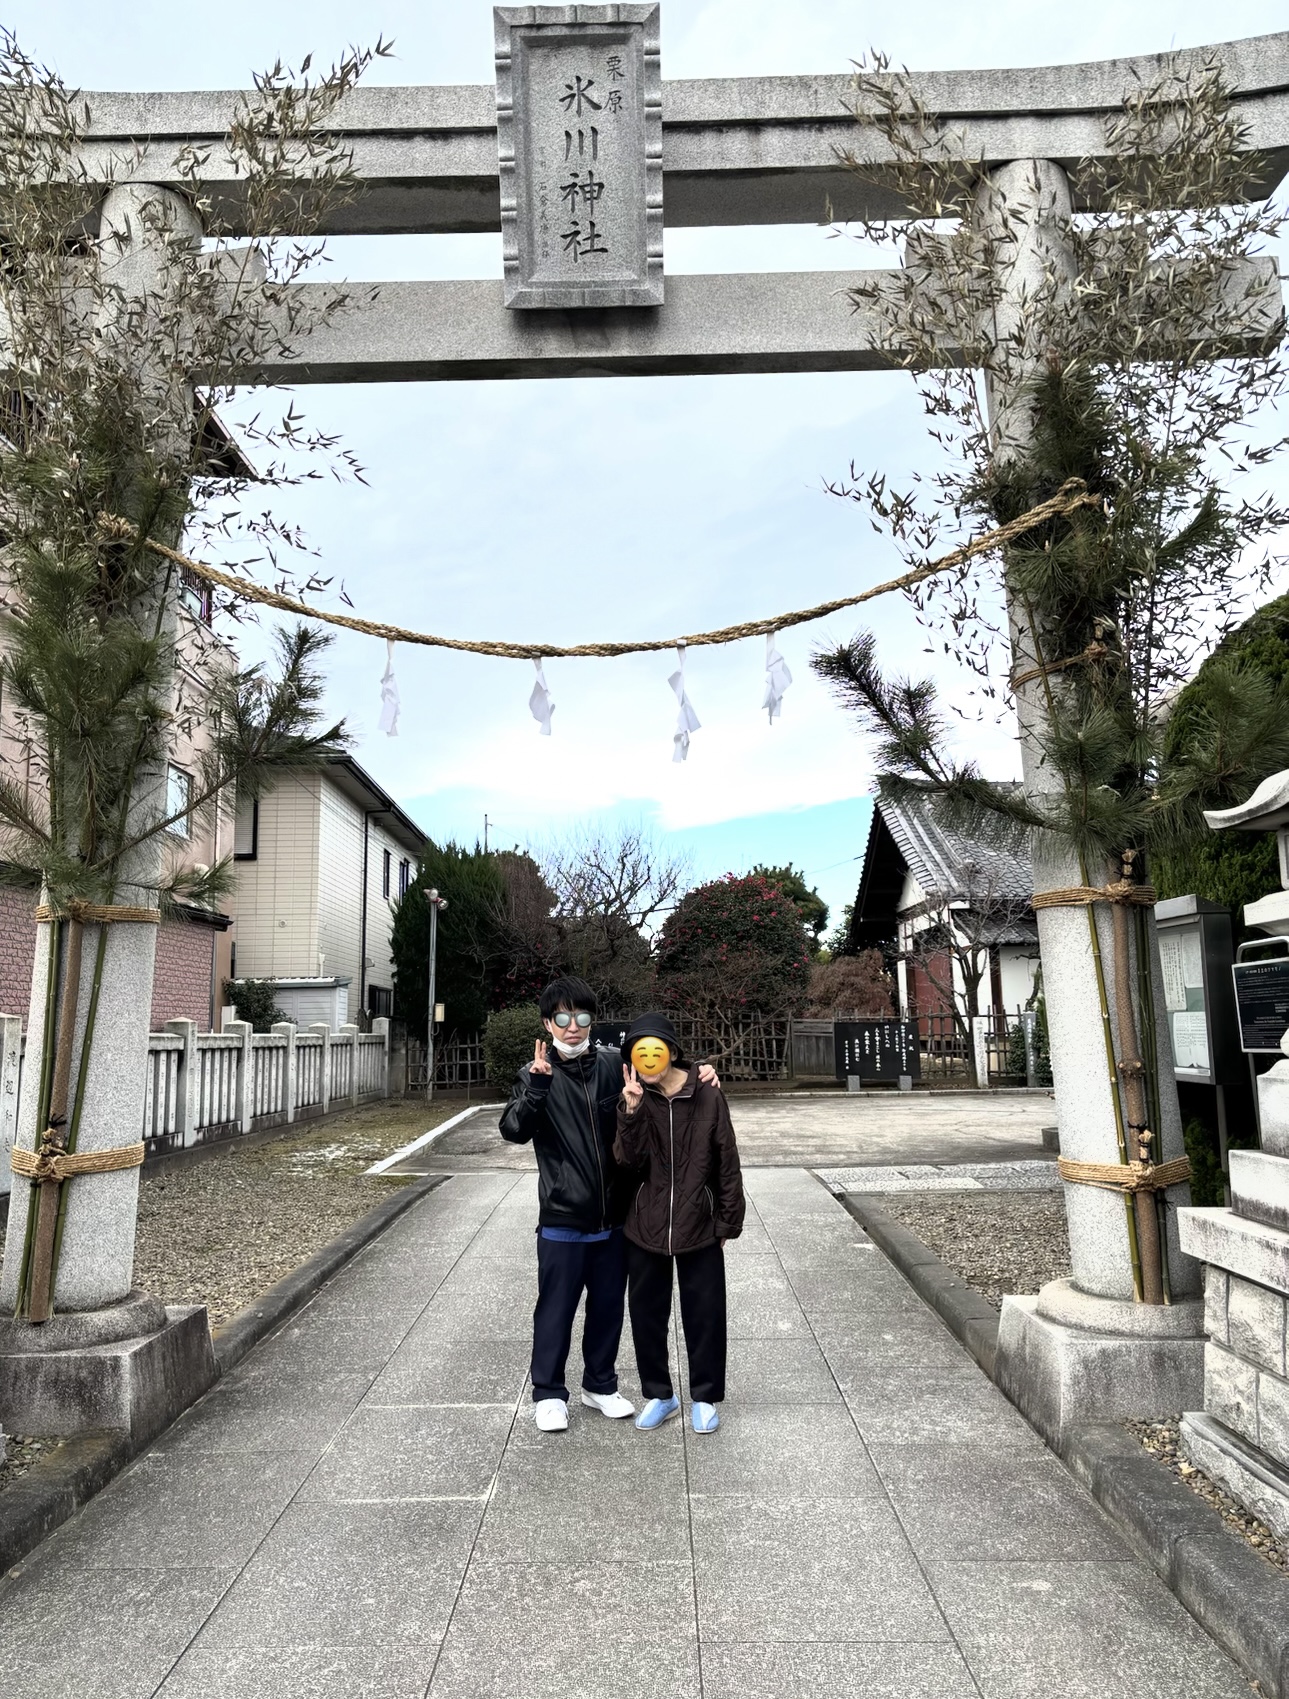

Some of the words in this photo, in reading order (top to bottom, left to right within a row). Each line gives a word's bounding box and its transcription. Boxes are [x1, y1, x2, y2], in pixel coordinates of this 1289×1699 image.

[603, 55, 625, 115] 栗原
[558, 75, 609, 263] 氷川神社
